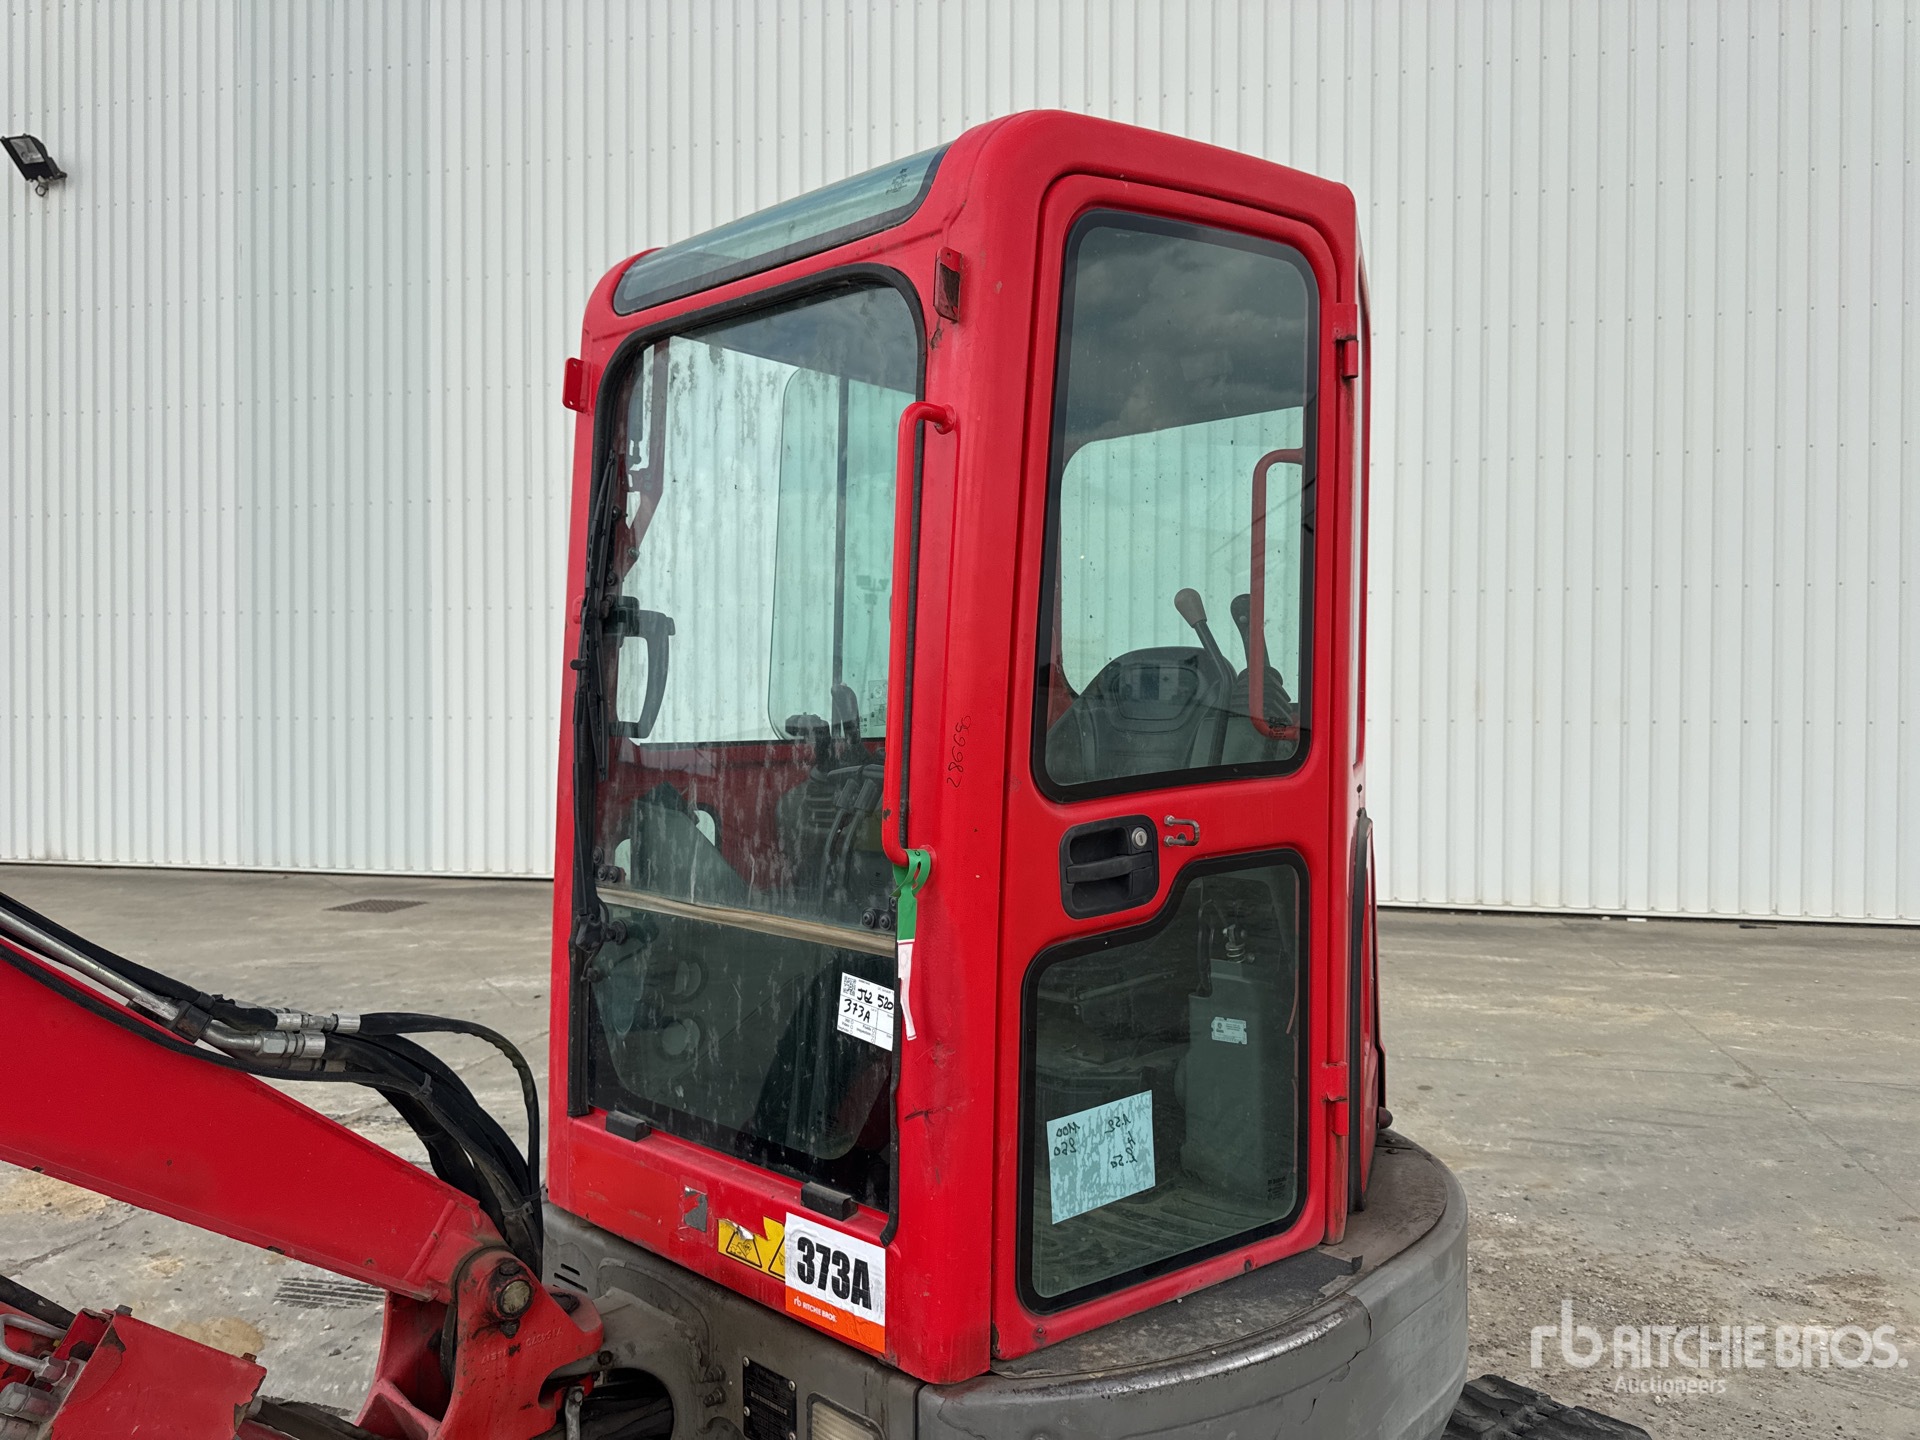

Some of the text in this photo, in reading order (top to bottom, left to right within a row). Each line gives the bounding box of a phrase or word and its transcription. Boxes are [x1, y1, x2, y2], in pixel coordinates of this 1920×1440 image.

[843, 998, 871, 1023] 373A
[877, 993, 894, 1011] 520
[796, 1236, 873, 1311] 373A
